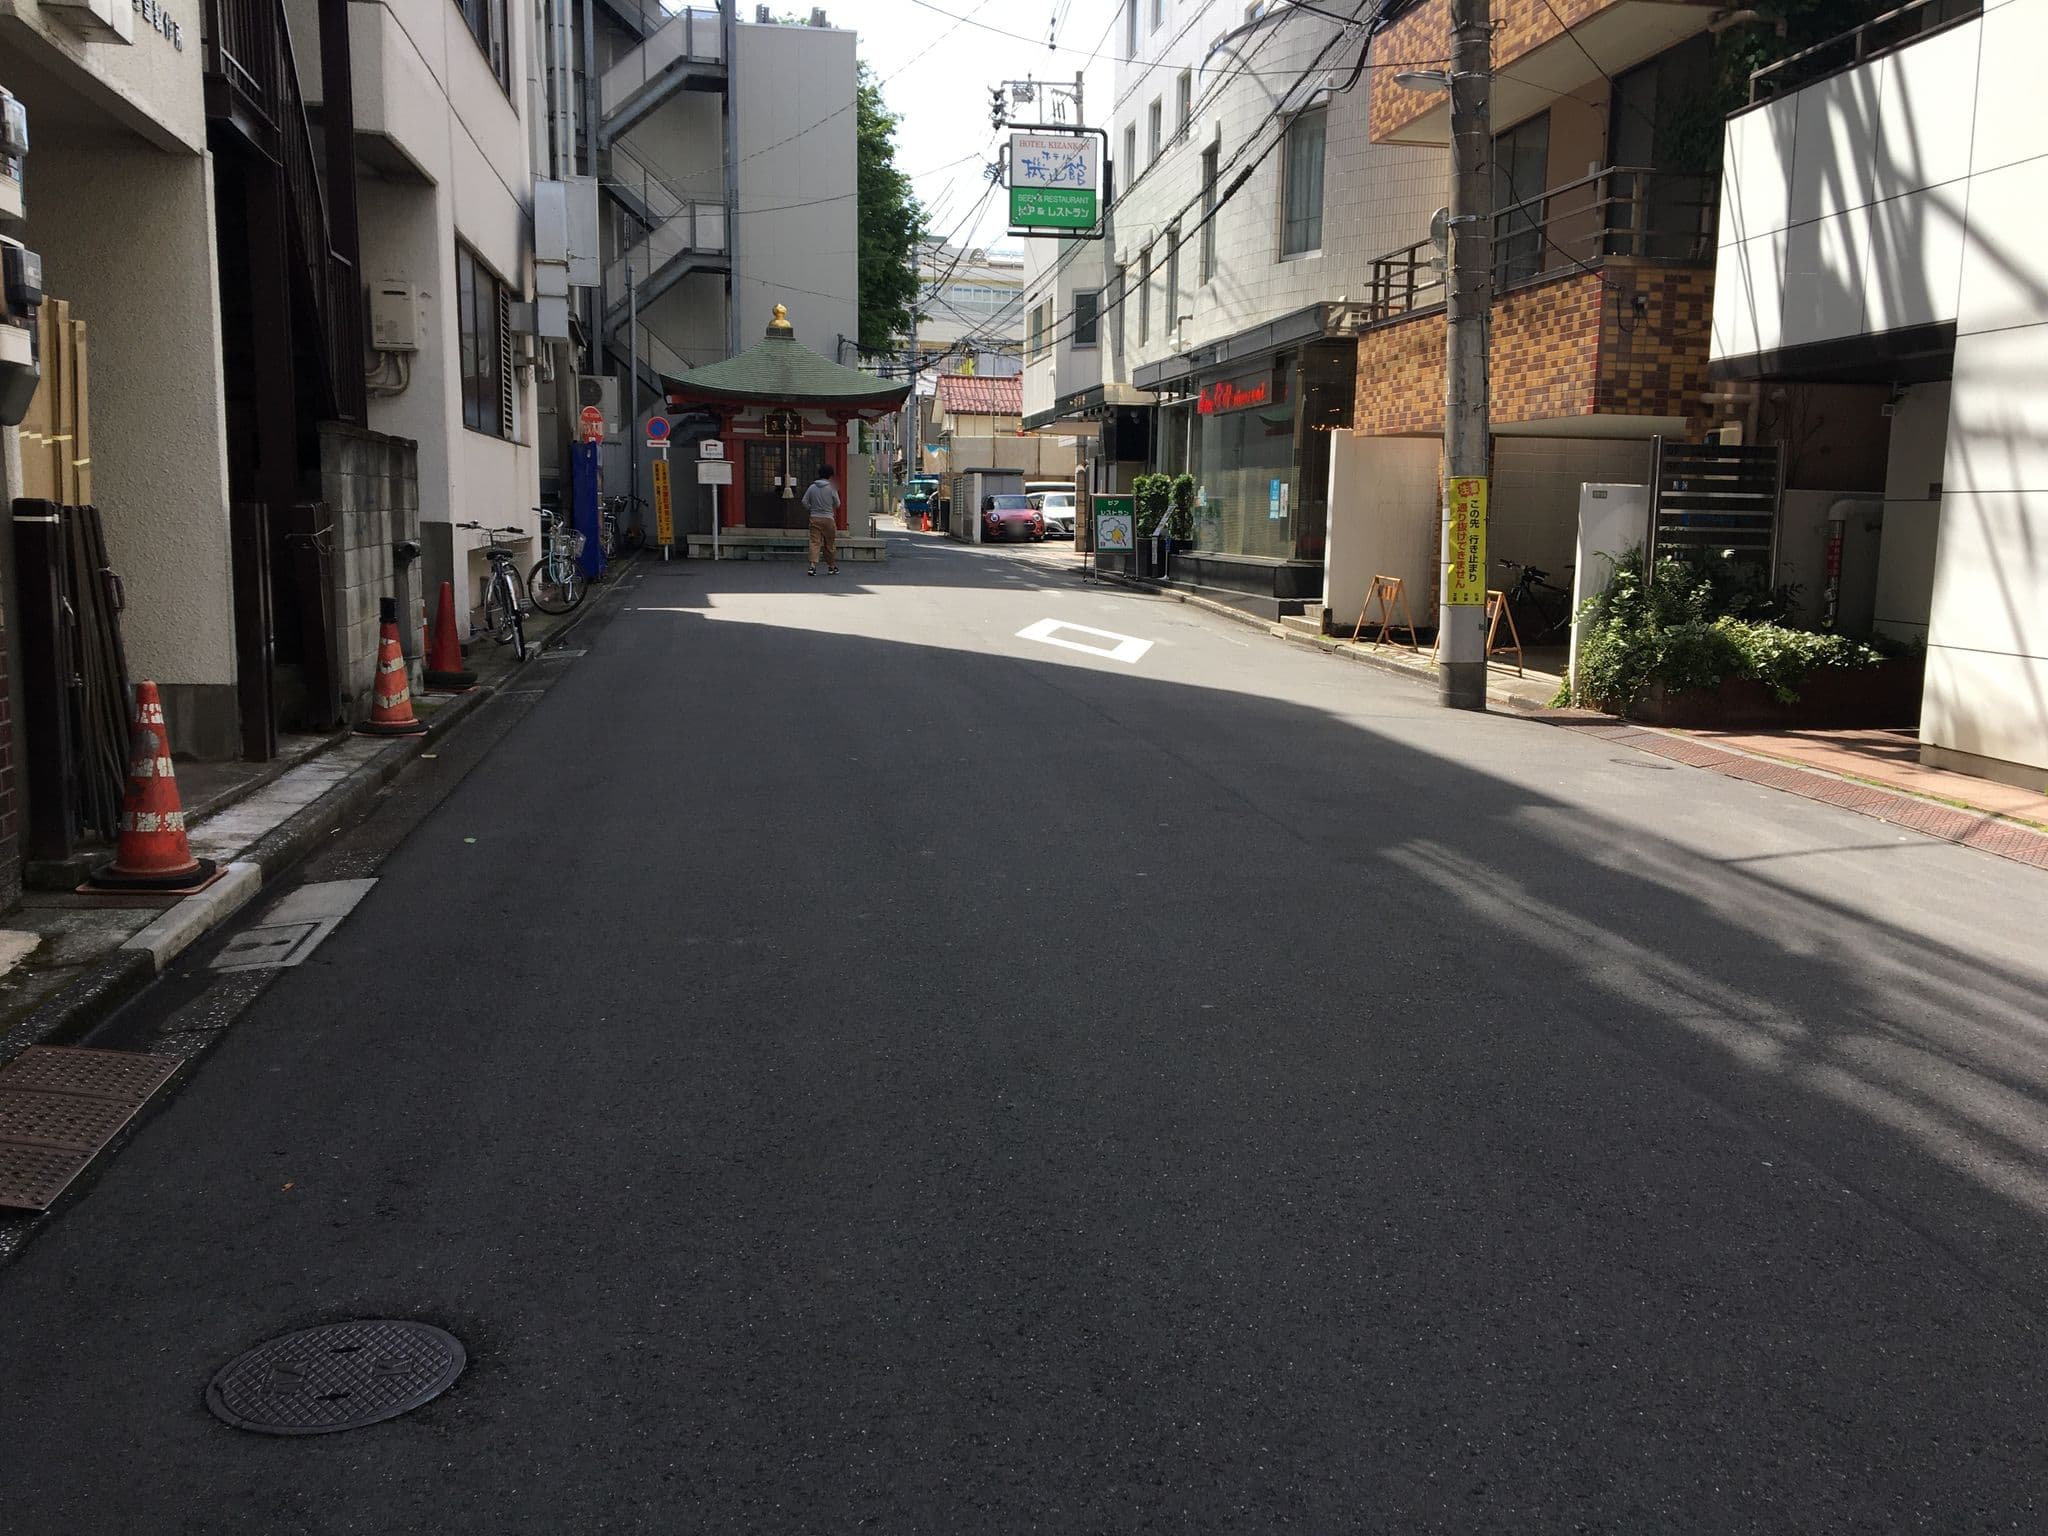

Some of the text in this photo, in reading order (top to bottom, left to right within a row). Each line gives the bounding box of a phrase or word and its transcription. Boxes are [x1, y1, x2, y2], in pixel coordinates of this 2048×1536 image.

[1019, 139, 1090, 151] HOTEL KIZANKAN
[1041, 151, 1072, 161] ホテル
[1044, 195, 1089, 204] RESTAURANT
[1048, 207, 1089, 218] レストラン
[1455, 503, 1467, 589] 通り抜けできません
[1468, 500, 1480, 583] この先 行き止まり
